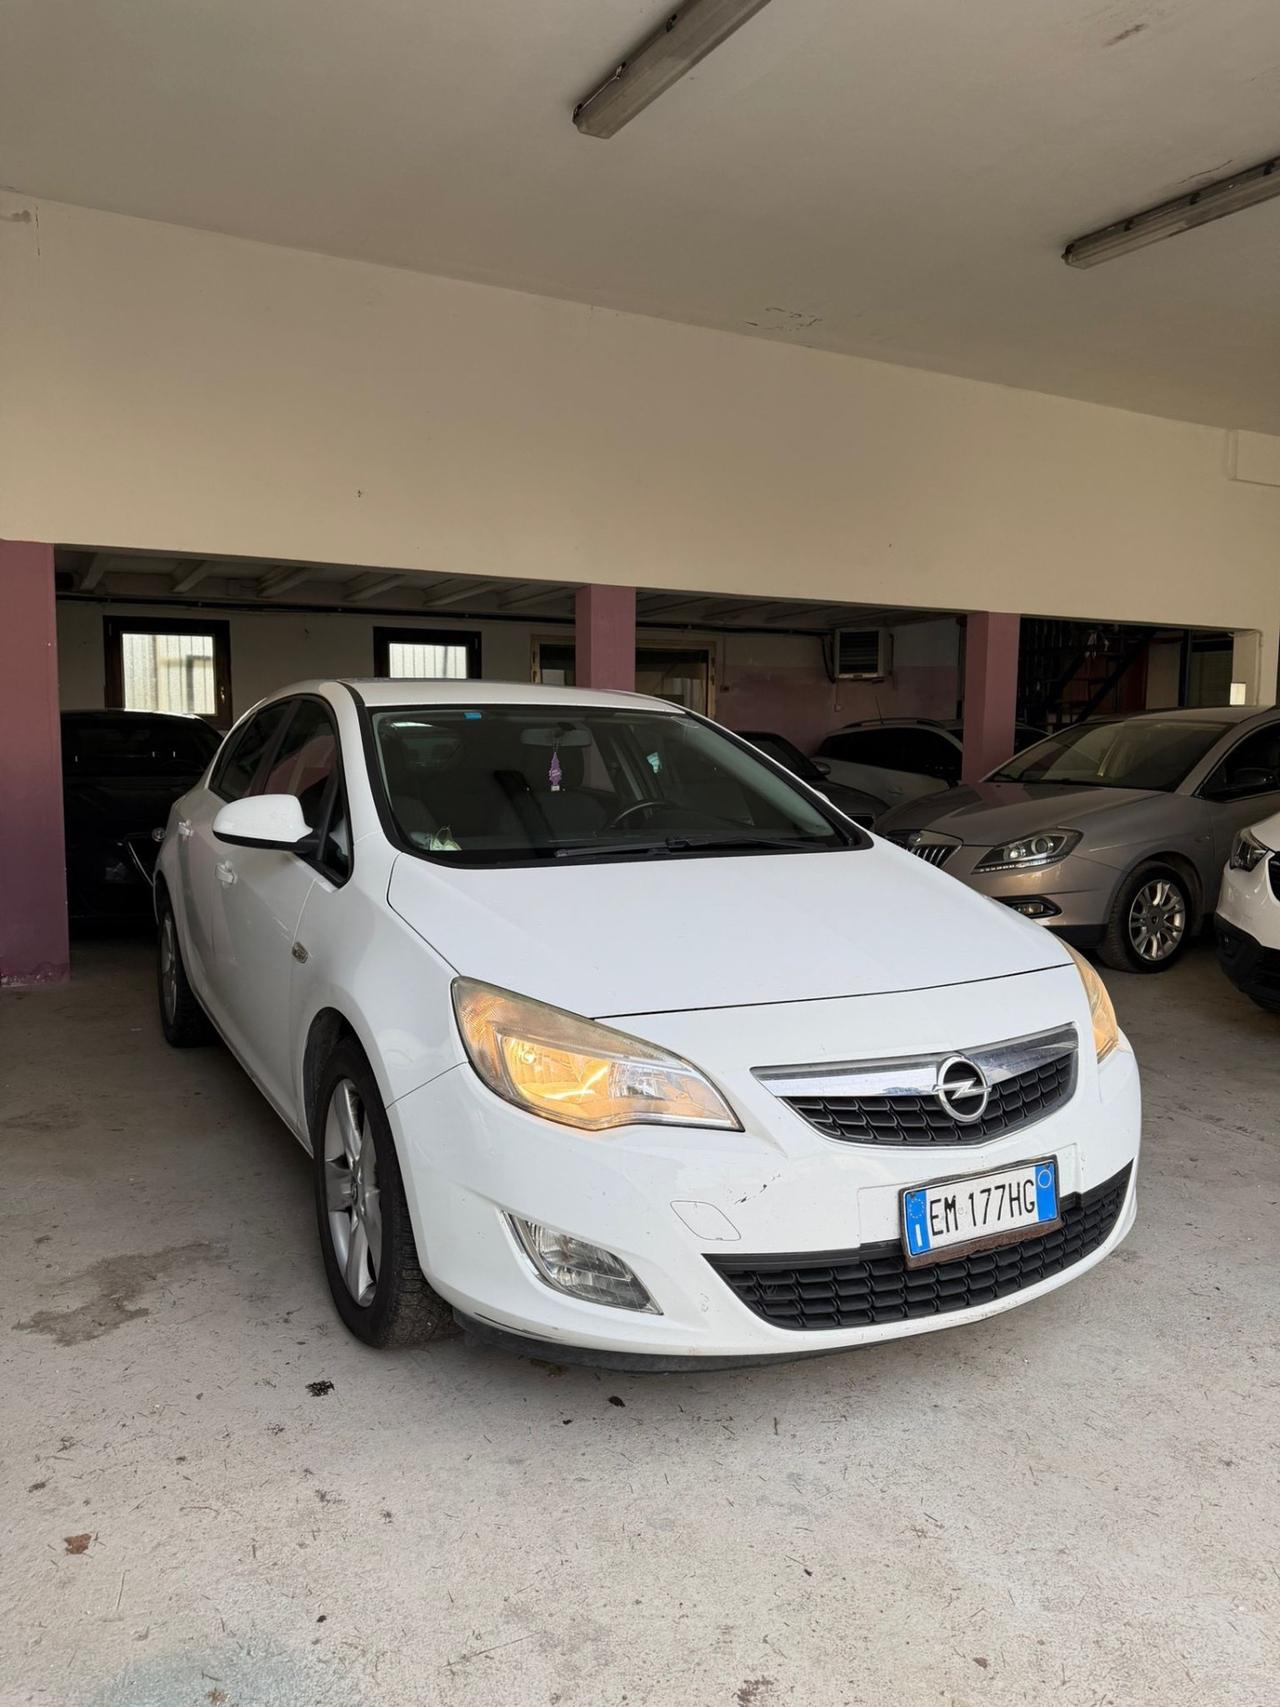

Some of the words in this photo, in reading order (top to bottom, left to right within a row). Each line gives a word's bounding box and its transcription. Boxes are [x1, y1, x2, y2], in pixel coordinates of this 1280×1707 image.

[929, 1194, 959, 1236] EM
[968, 1179, 1036, 1227] 177HG
[915, 1223, 923, 1247] I
